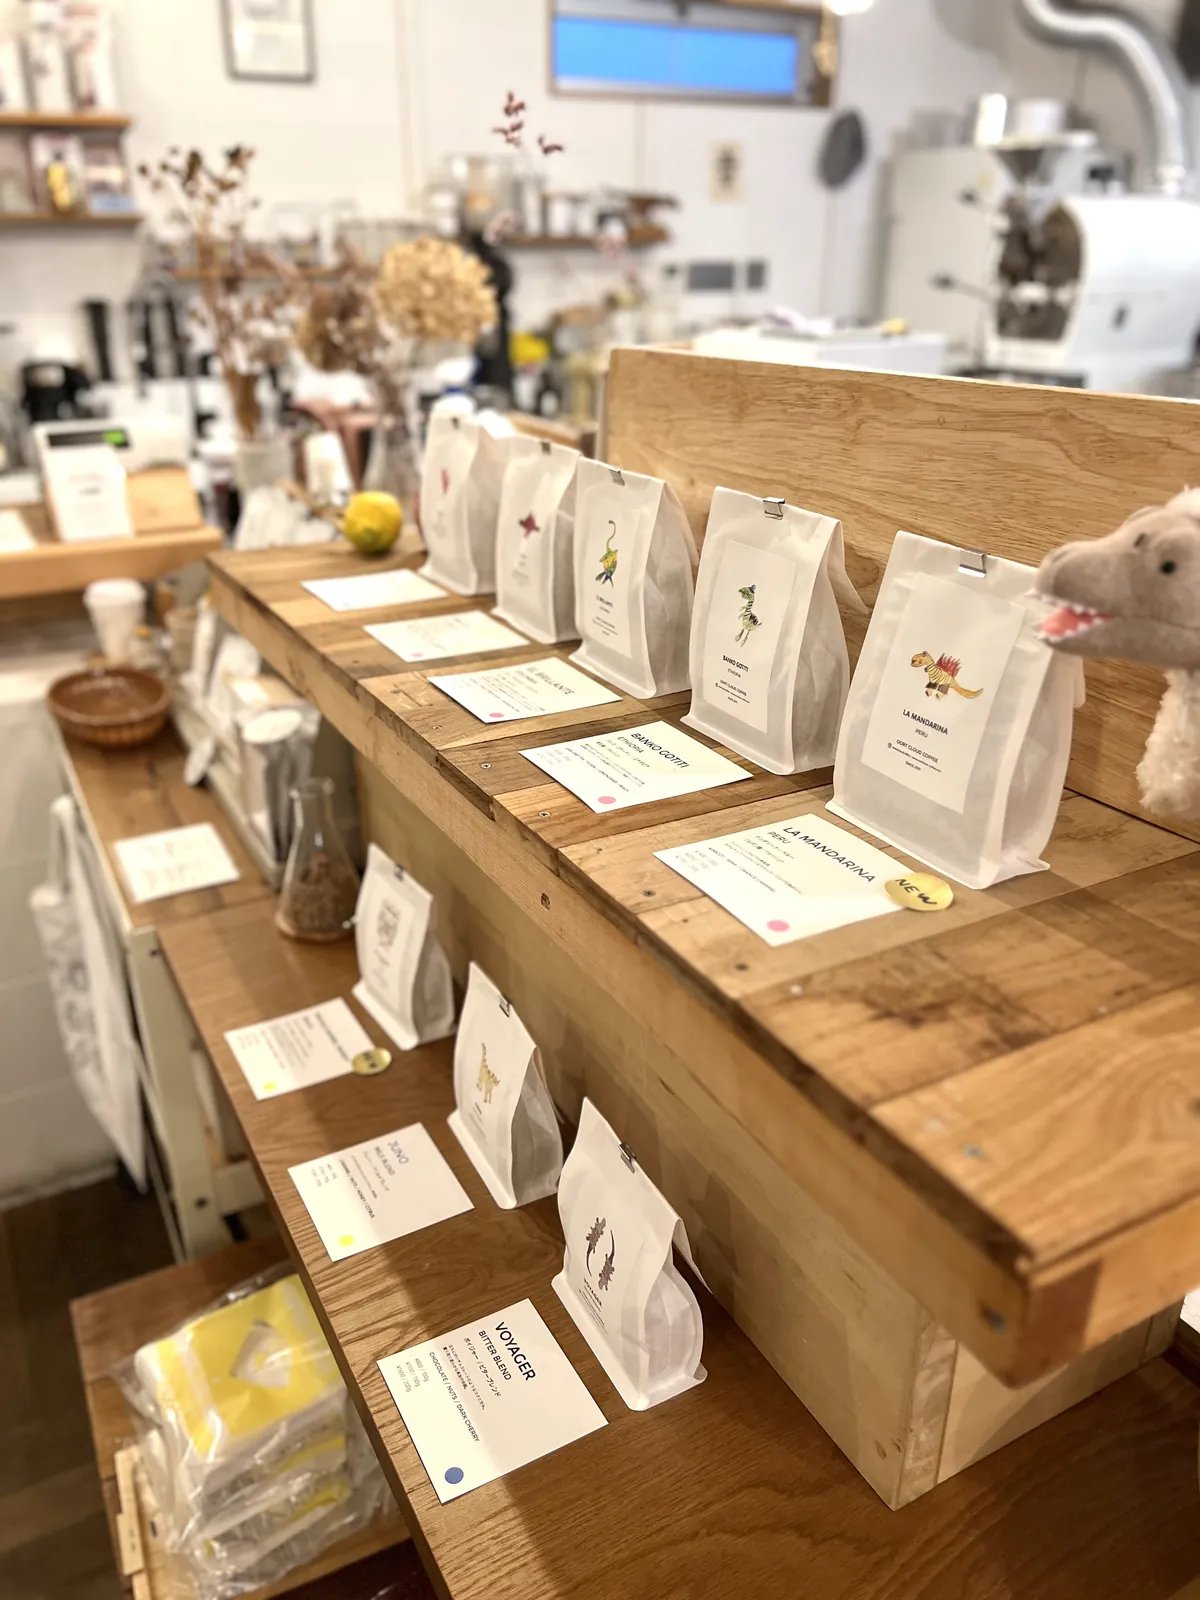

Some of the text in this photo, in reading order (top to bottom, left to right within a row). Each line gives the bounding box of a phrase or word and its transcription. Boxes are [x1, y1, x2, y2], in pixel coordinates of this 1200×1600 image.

[902, 708, 949, 735] LA MANDARINA
[631, 732, 662, 751] BANKO
[659, 749, 690, 769] GOTITI
[767, 831, 792, 844] PERU
[783, 826, 802, 838] LA
[798, 835, 877, 883] MANDARINA
[894, 878, 938, 905] NEW
[388, 1140, 409, 1165] JUNO
[479, 1330, 511, 1381] BITTER BLEND
[494, 1321, 537, 1381] VOYAGER
[430, 1352, 447, 1382] CHOCOLATE
[447, 1385, 457, 1400] NUTS
[457, 1404, 467, 1420] DARK
[465, 1420, 478, 1442] CHERRY
